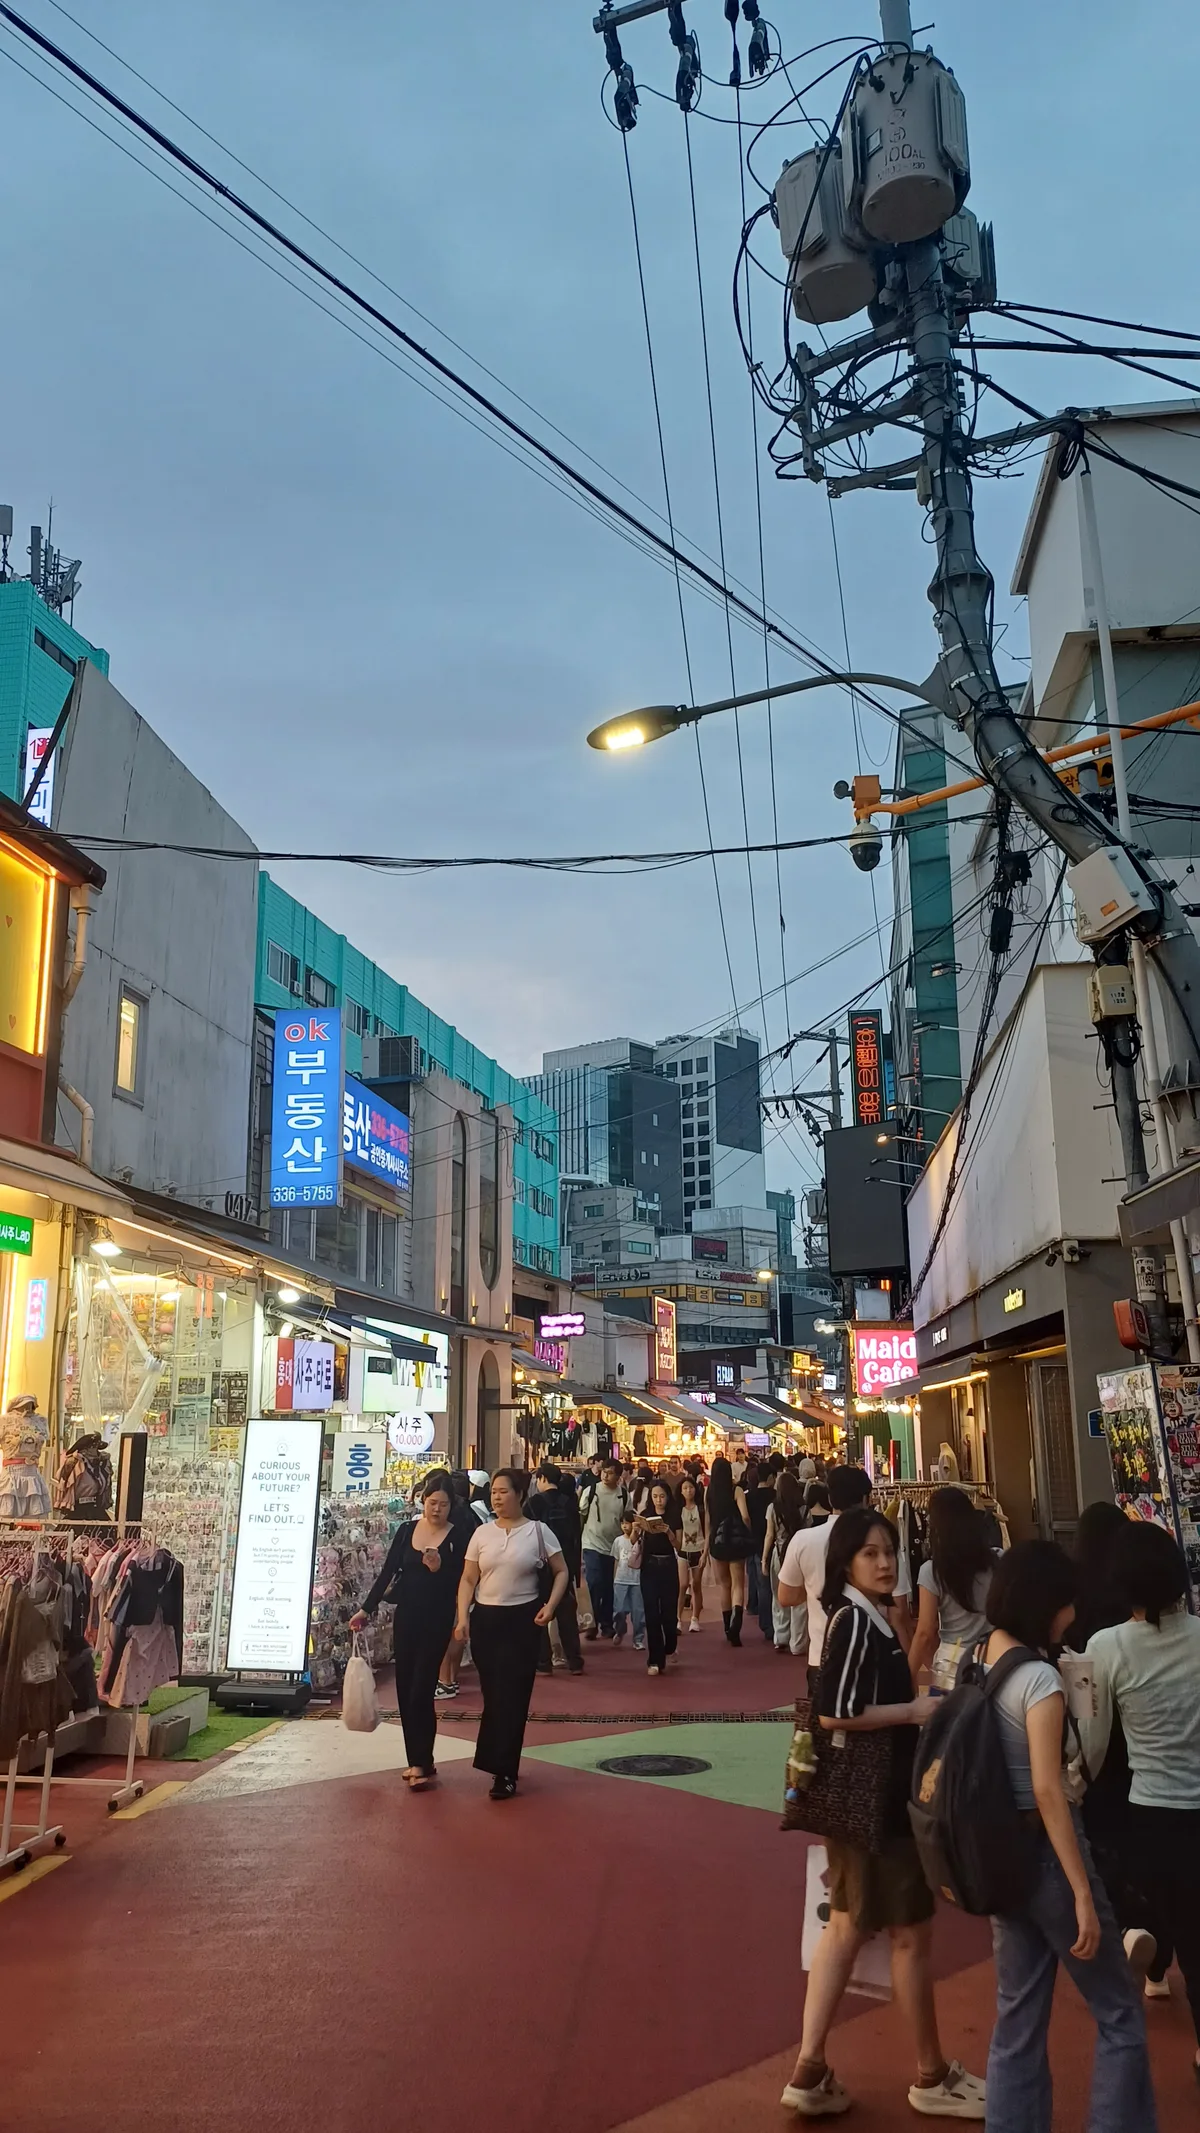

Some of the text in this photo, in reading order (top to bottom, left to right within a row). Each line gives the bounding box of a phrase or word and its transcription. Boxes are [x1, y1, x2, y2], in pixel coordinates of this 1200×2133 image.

[284, 1017, 331, 1043] ok
[282, 1049, 328, 1173] 부동산
[273, 1185, 334, 1202] 336-5755
[858, 1335, 917, 1360] Maid
[863, 1361, 914, 1384] Cafe
[397, 1416, 422, 1433] 사주
[259, 1461, 301, 1470] CURIOUS
[252, 1472, 310, 1482] ABOUT YOUR
[259, 1484, 301, 1493] FUTURE?
[263, 1503, 290, 1512] LET'S
[248, 1514, 296, 1524] FIND OUT.
